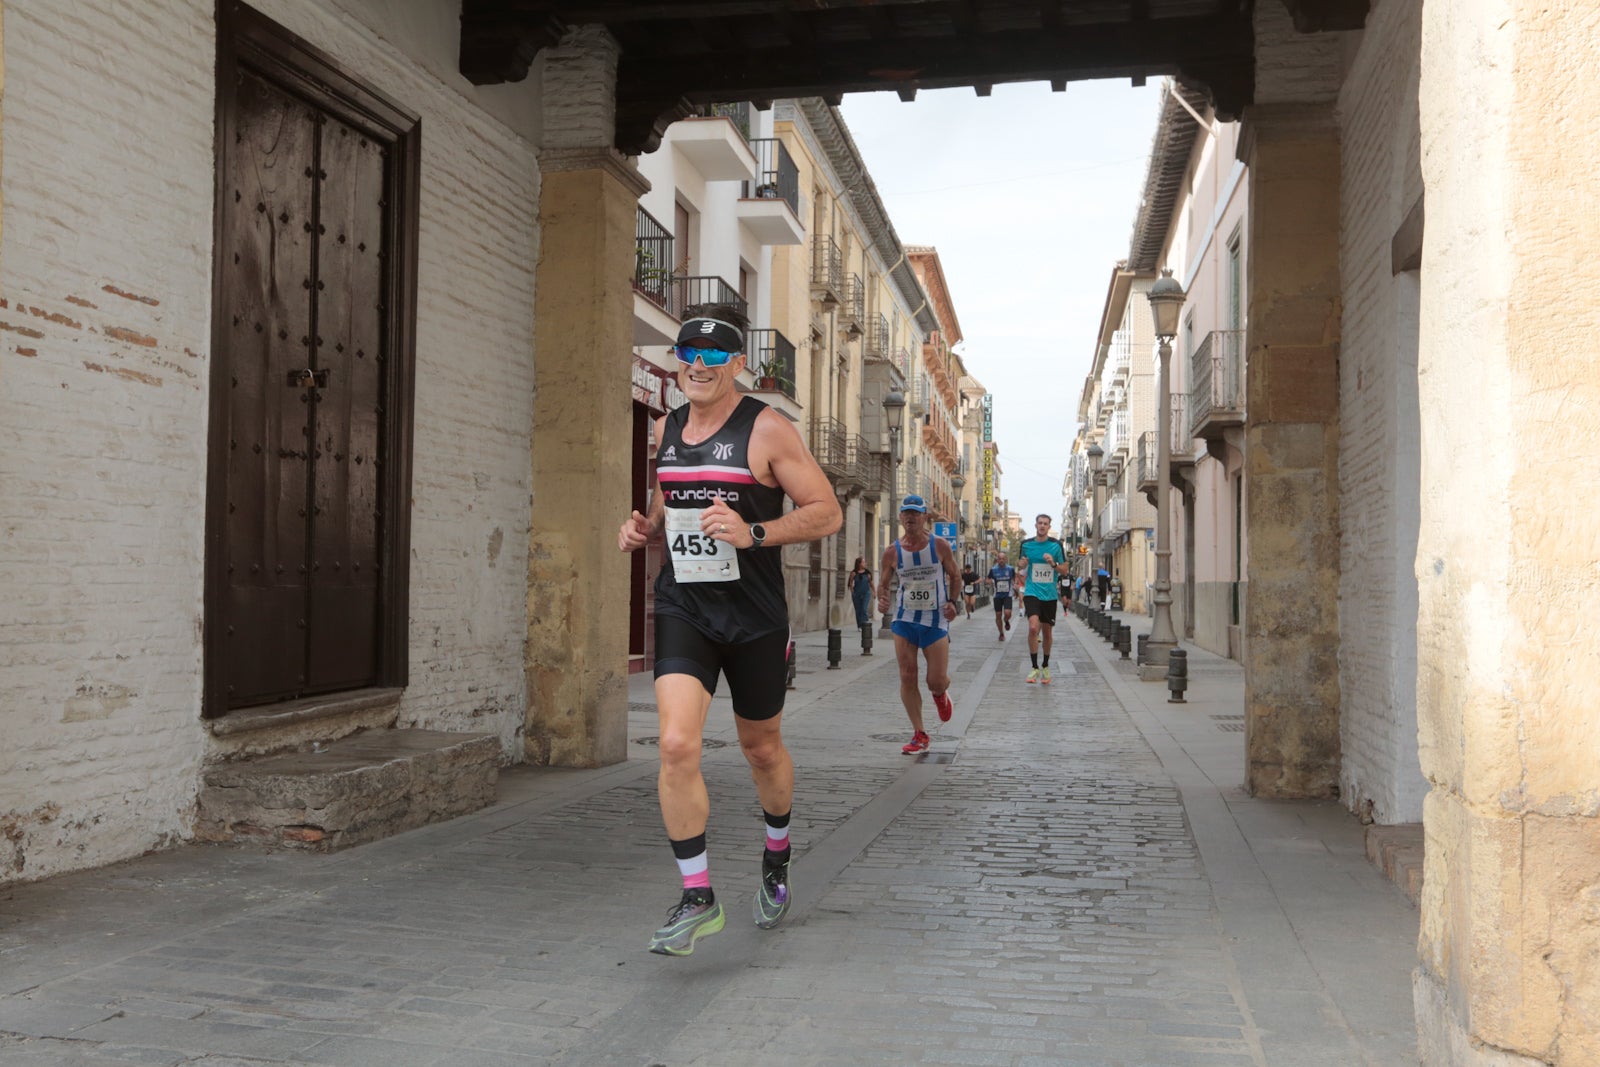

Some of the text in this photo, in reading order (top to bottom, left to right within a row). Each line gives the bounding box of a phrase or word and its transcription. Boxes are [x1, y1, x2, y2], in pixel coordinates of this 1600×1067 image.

[984, 394, 992, 441] TEJIDOS
[672, 533, 718, 556] 453
[910, 591, 929, 600] 350
